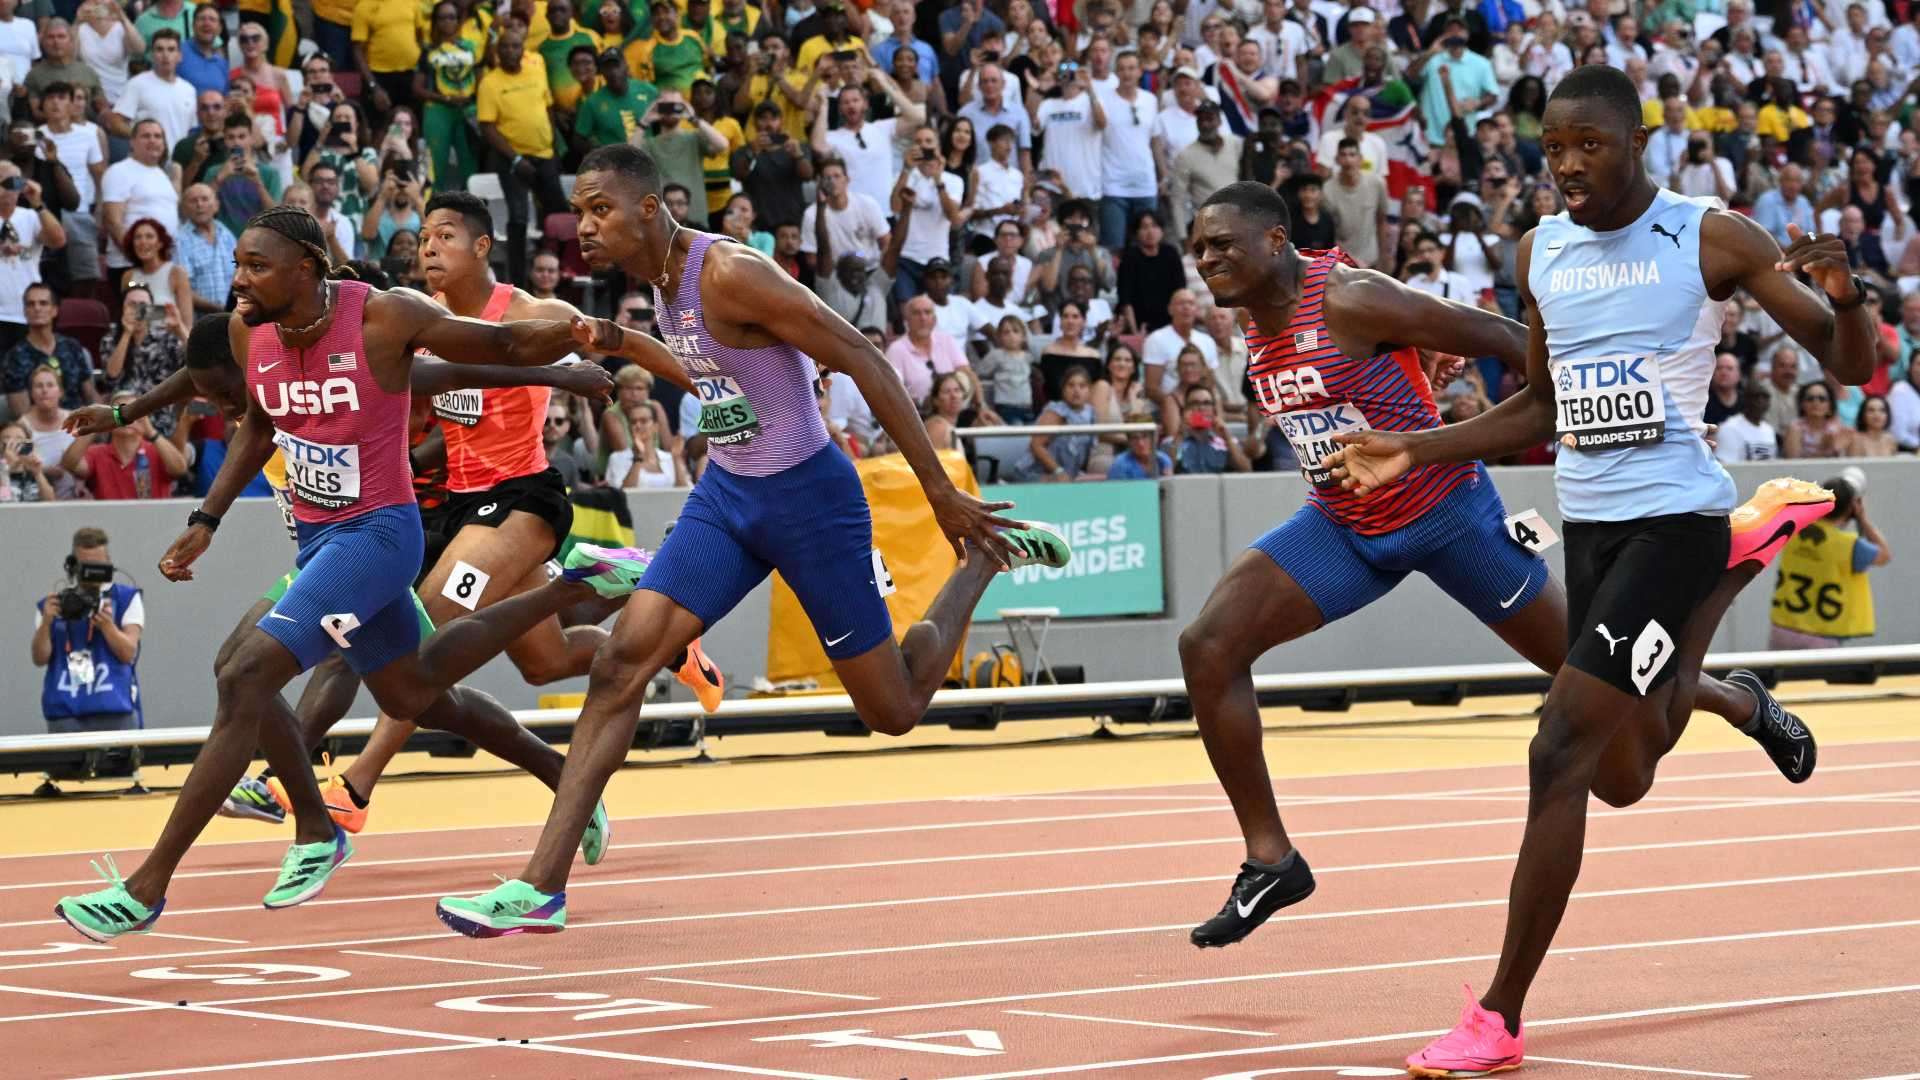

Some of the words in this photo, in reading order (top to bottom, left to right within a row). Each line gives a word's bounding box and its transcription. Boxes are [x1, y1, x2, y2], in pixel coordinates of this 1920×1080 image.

[1550, 260, 1661, 292] BOTSWANA
[1571, 357, 1649, 390] TDK
[256, 377, 360, 417] USA
[439, 392, 479, 411] BROWN
[1255, 366, 1331, 413] USA
[1291, 405, 1355, 435] TDK
[1560, 390, 1654, 427] TEBOGO
[289, 438, 351, 467] TDK
[1579, 430, 1642, 446] BUDAPEST
[1643, 428, 1658, 440] 23
[297, 489, 341, 508] BUDAPEST
[1514, 520, 1541, 545] 4
[1012, 542, 1145, 585] WONDER
[455, 572, 477, 599] 8
[1636, 638, 1664, 677] 3
